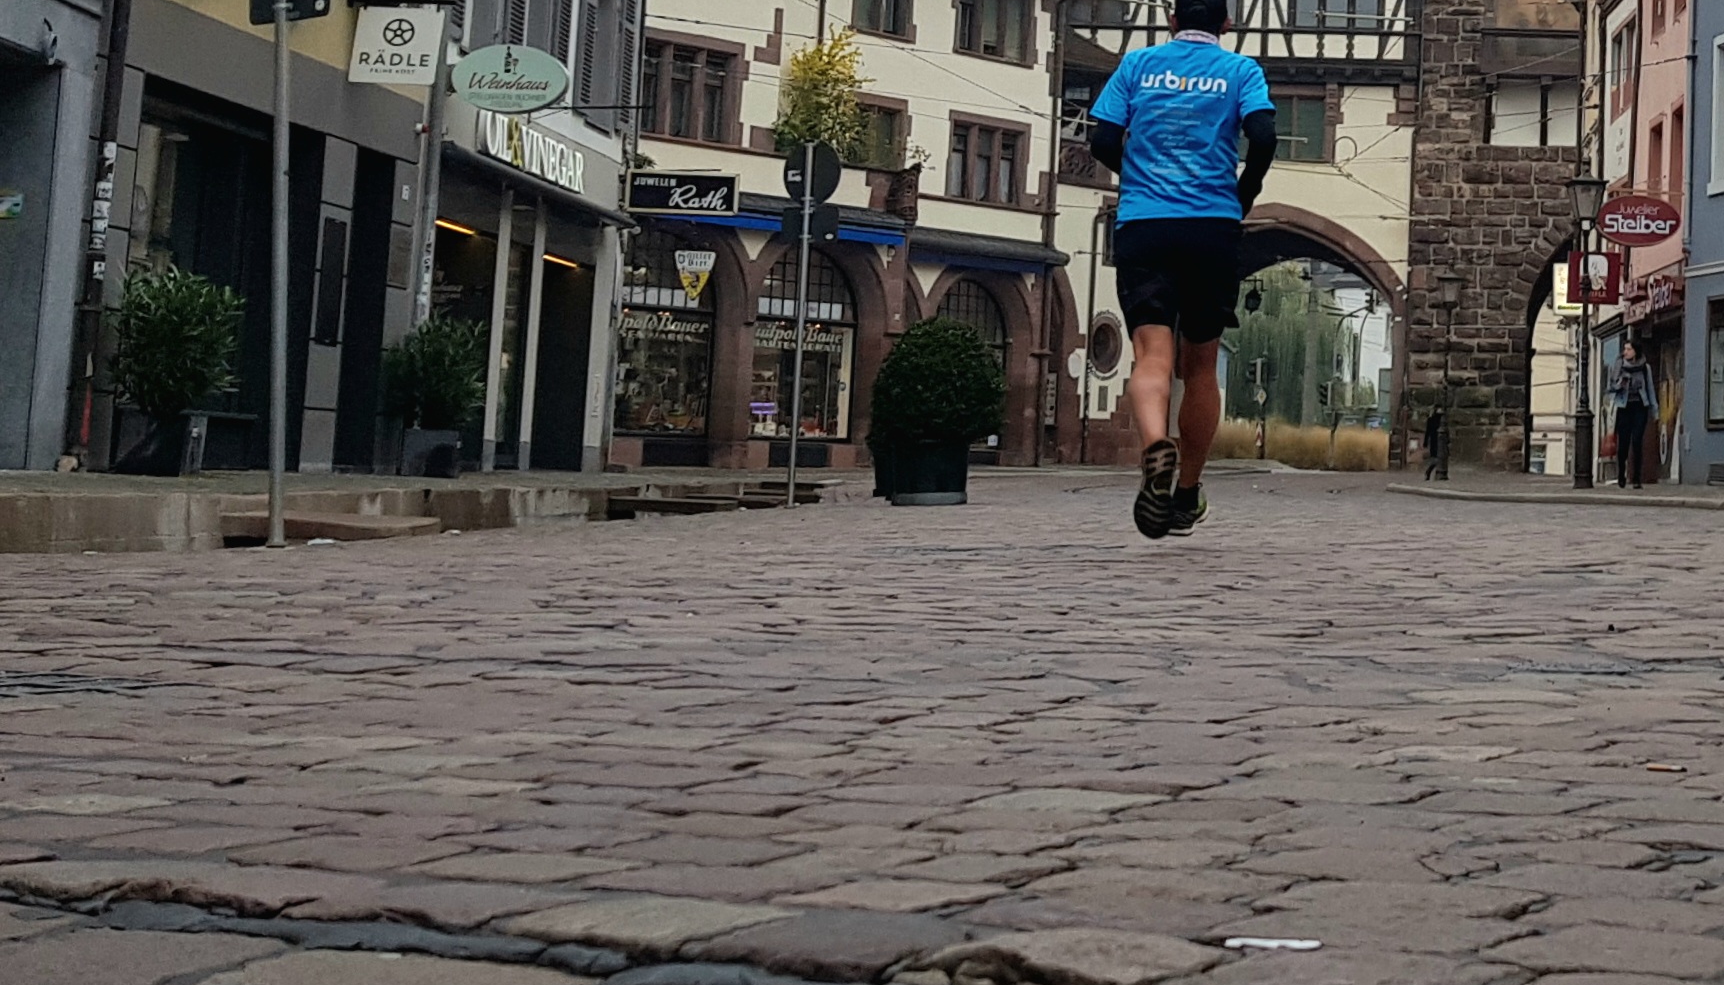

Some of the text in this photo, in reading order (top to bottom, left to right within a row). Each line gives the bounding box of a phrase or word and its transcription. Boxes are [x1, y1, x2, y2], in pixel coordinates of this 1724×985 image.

[358, 49, 430, 68] RÄDLE
[468, 72, 550, 91] Weinhaus
[668, 184, 728, 211] Rath
[1616, 202, 1660, 215] Juwelier
[1603, 213, 1677, 235] Steiber
[805, 326, 843, 344] Baue
